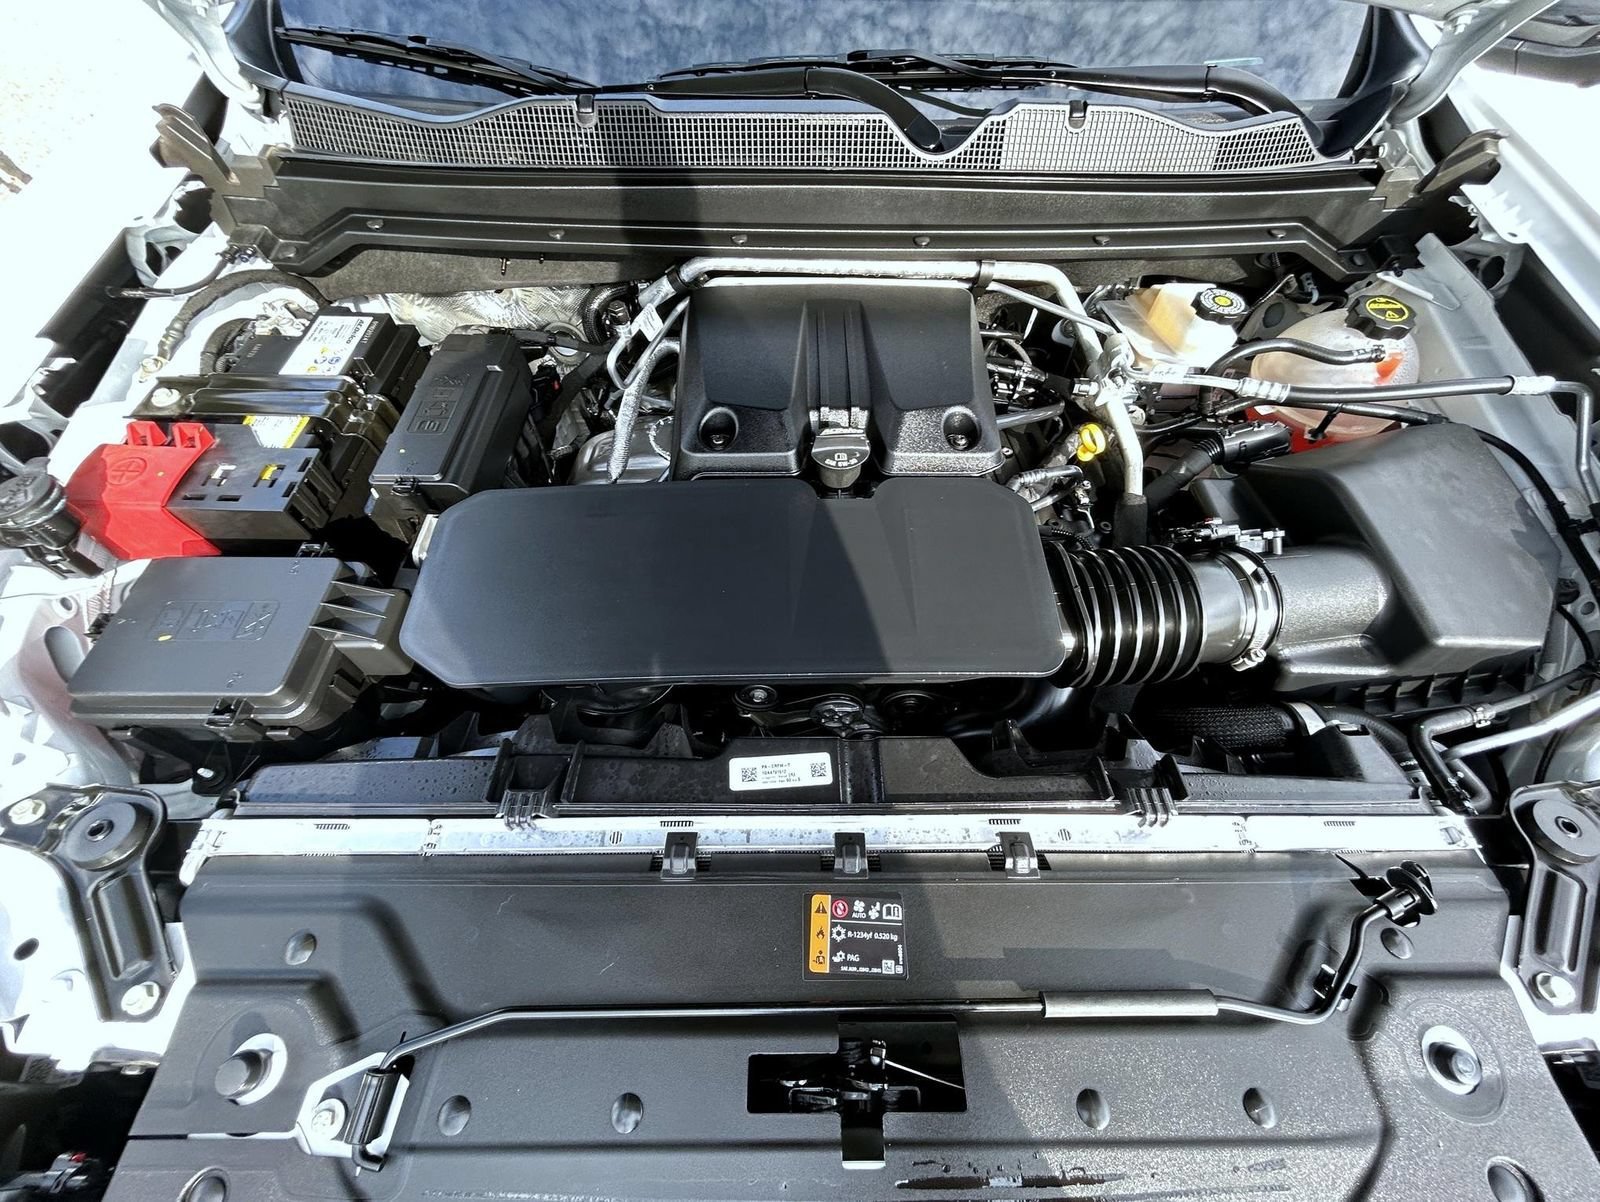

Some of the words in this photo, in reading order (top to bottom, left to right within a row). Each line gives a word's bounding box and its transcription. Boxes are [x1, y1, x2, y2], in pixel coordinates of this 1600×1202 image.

[847, 931, 873, 940] R-1234yf
[873, 932, 890, 940] 0.520
[846, 953, 860, 962] PAG
